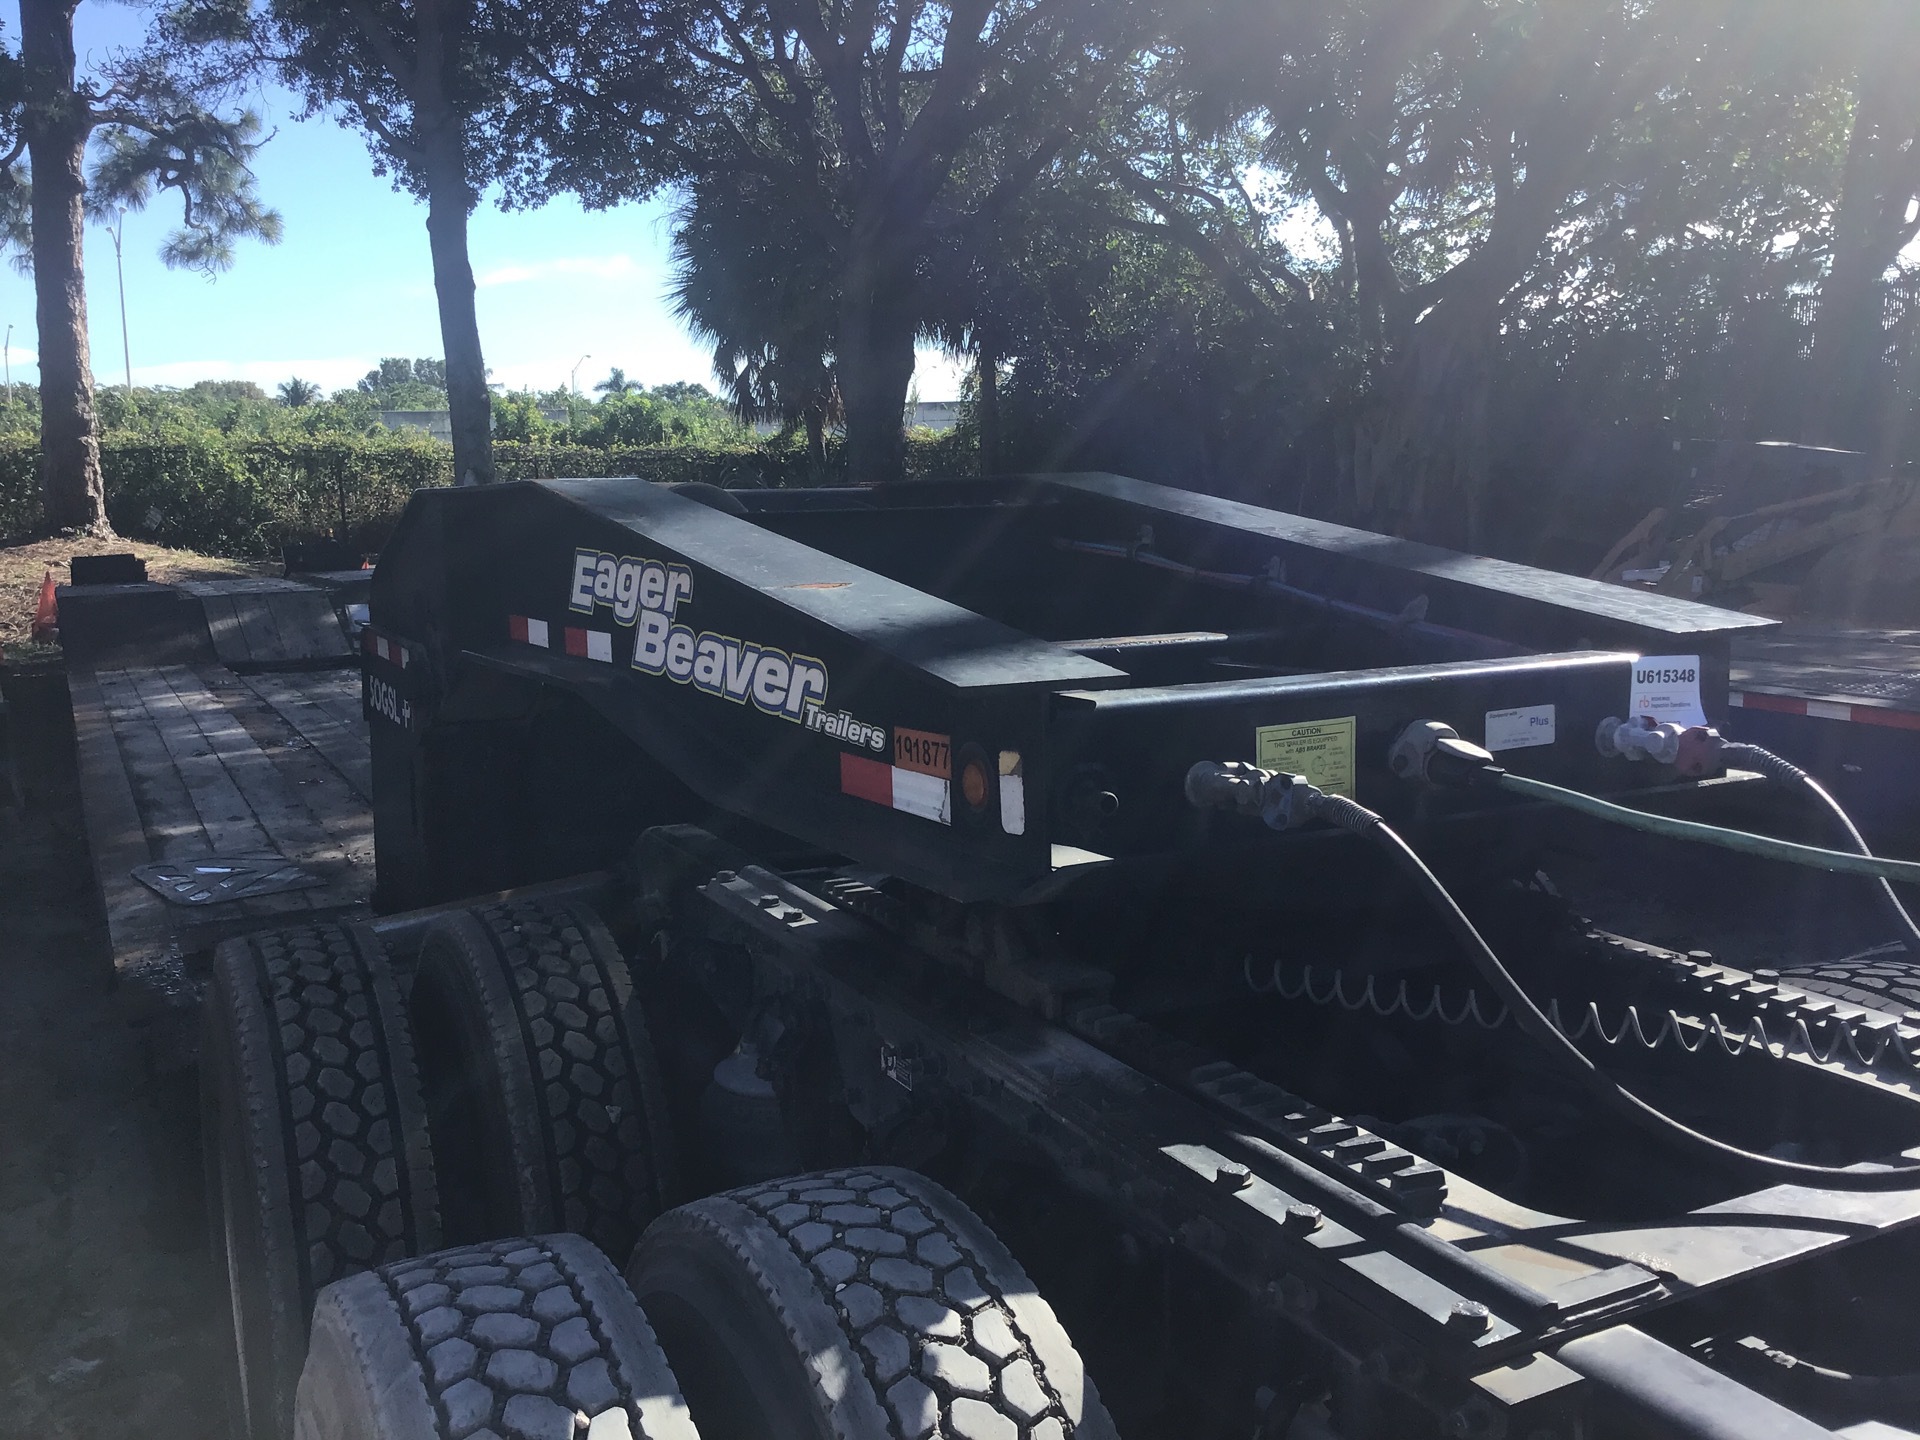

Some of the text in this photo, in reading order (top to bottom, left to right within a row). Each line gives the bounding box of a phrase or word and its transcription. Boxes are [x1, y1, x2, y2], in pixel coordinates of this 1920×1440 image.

[570, 548, 692, 625] Eager
[632, 608, 827, 722] Beaver
[1636, 669, 1695, 684] U615348
[805, 704, 885, 751] Trailers
[1530, 717, 1549, 727] Plus
[1291, 728, 1322, 736] CAUTION
[1286, 739, 1307, 748] TRAILER
[1313, 736, 1338, 744] EQUIPPED
[1295, 745, 1306, 753] ABS
[1306, 744, 1327, 752] BRAKES
[896, 735, 949, 769] 191877
